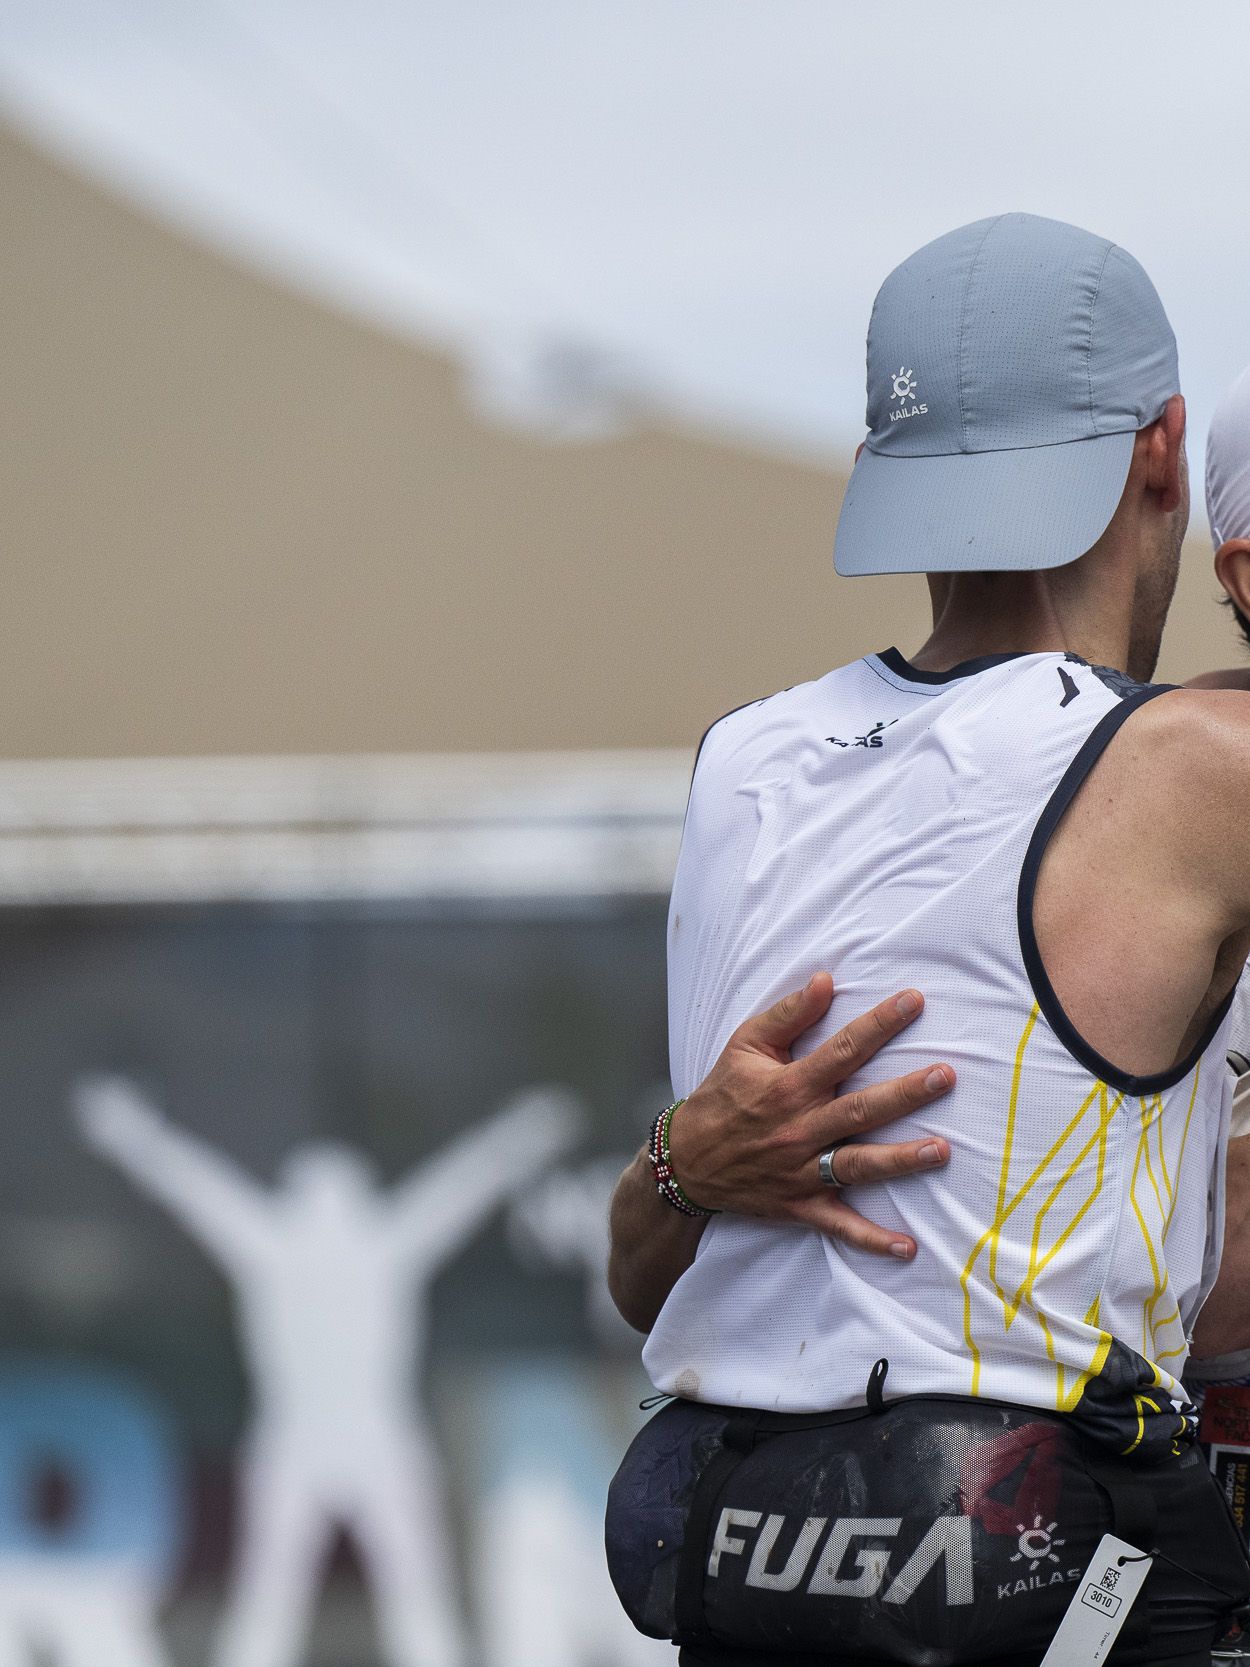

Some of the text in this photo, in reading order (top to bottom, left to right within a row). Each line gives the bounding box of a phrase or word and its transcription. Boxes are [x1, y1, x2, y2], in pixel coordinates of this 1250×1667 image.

[889, 403, 929, 422] KAILAS
[707, 1507, 974, 1606] FUGA
[997, 1568, 1081, 1600] KAILAS
[1090, 1590, 1113, 1608] 3010
